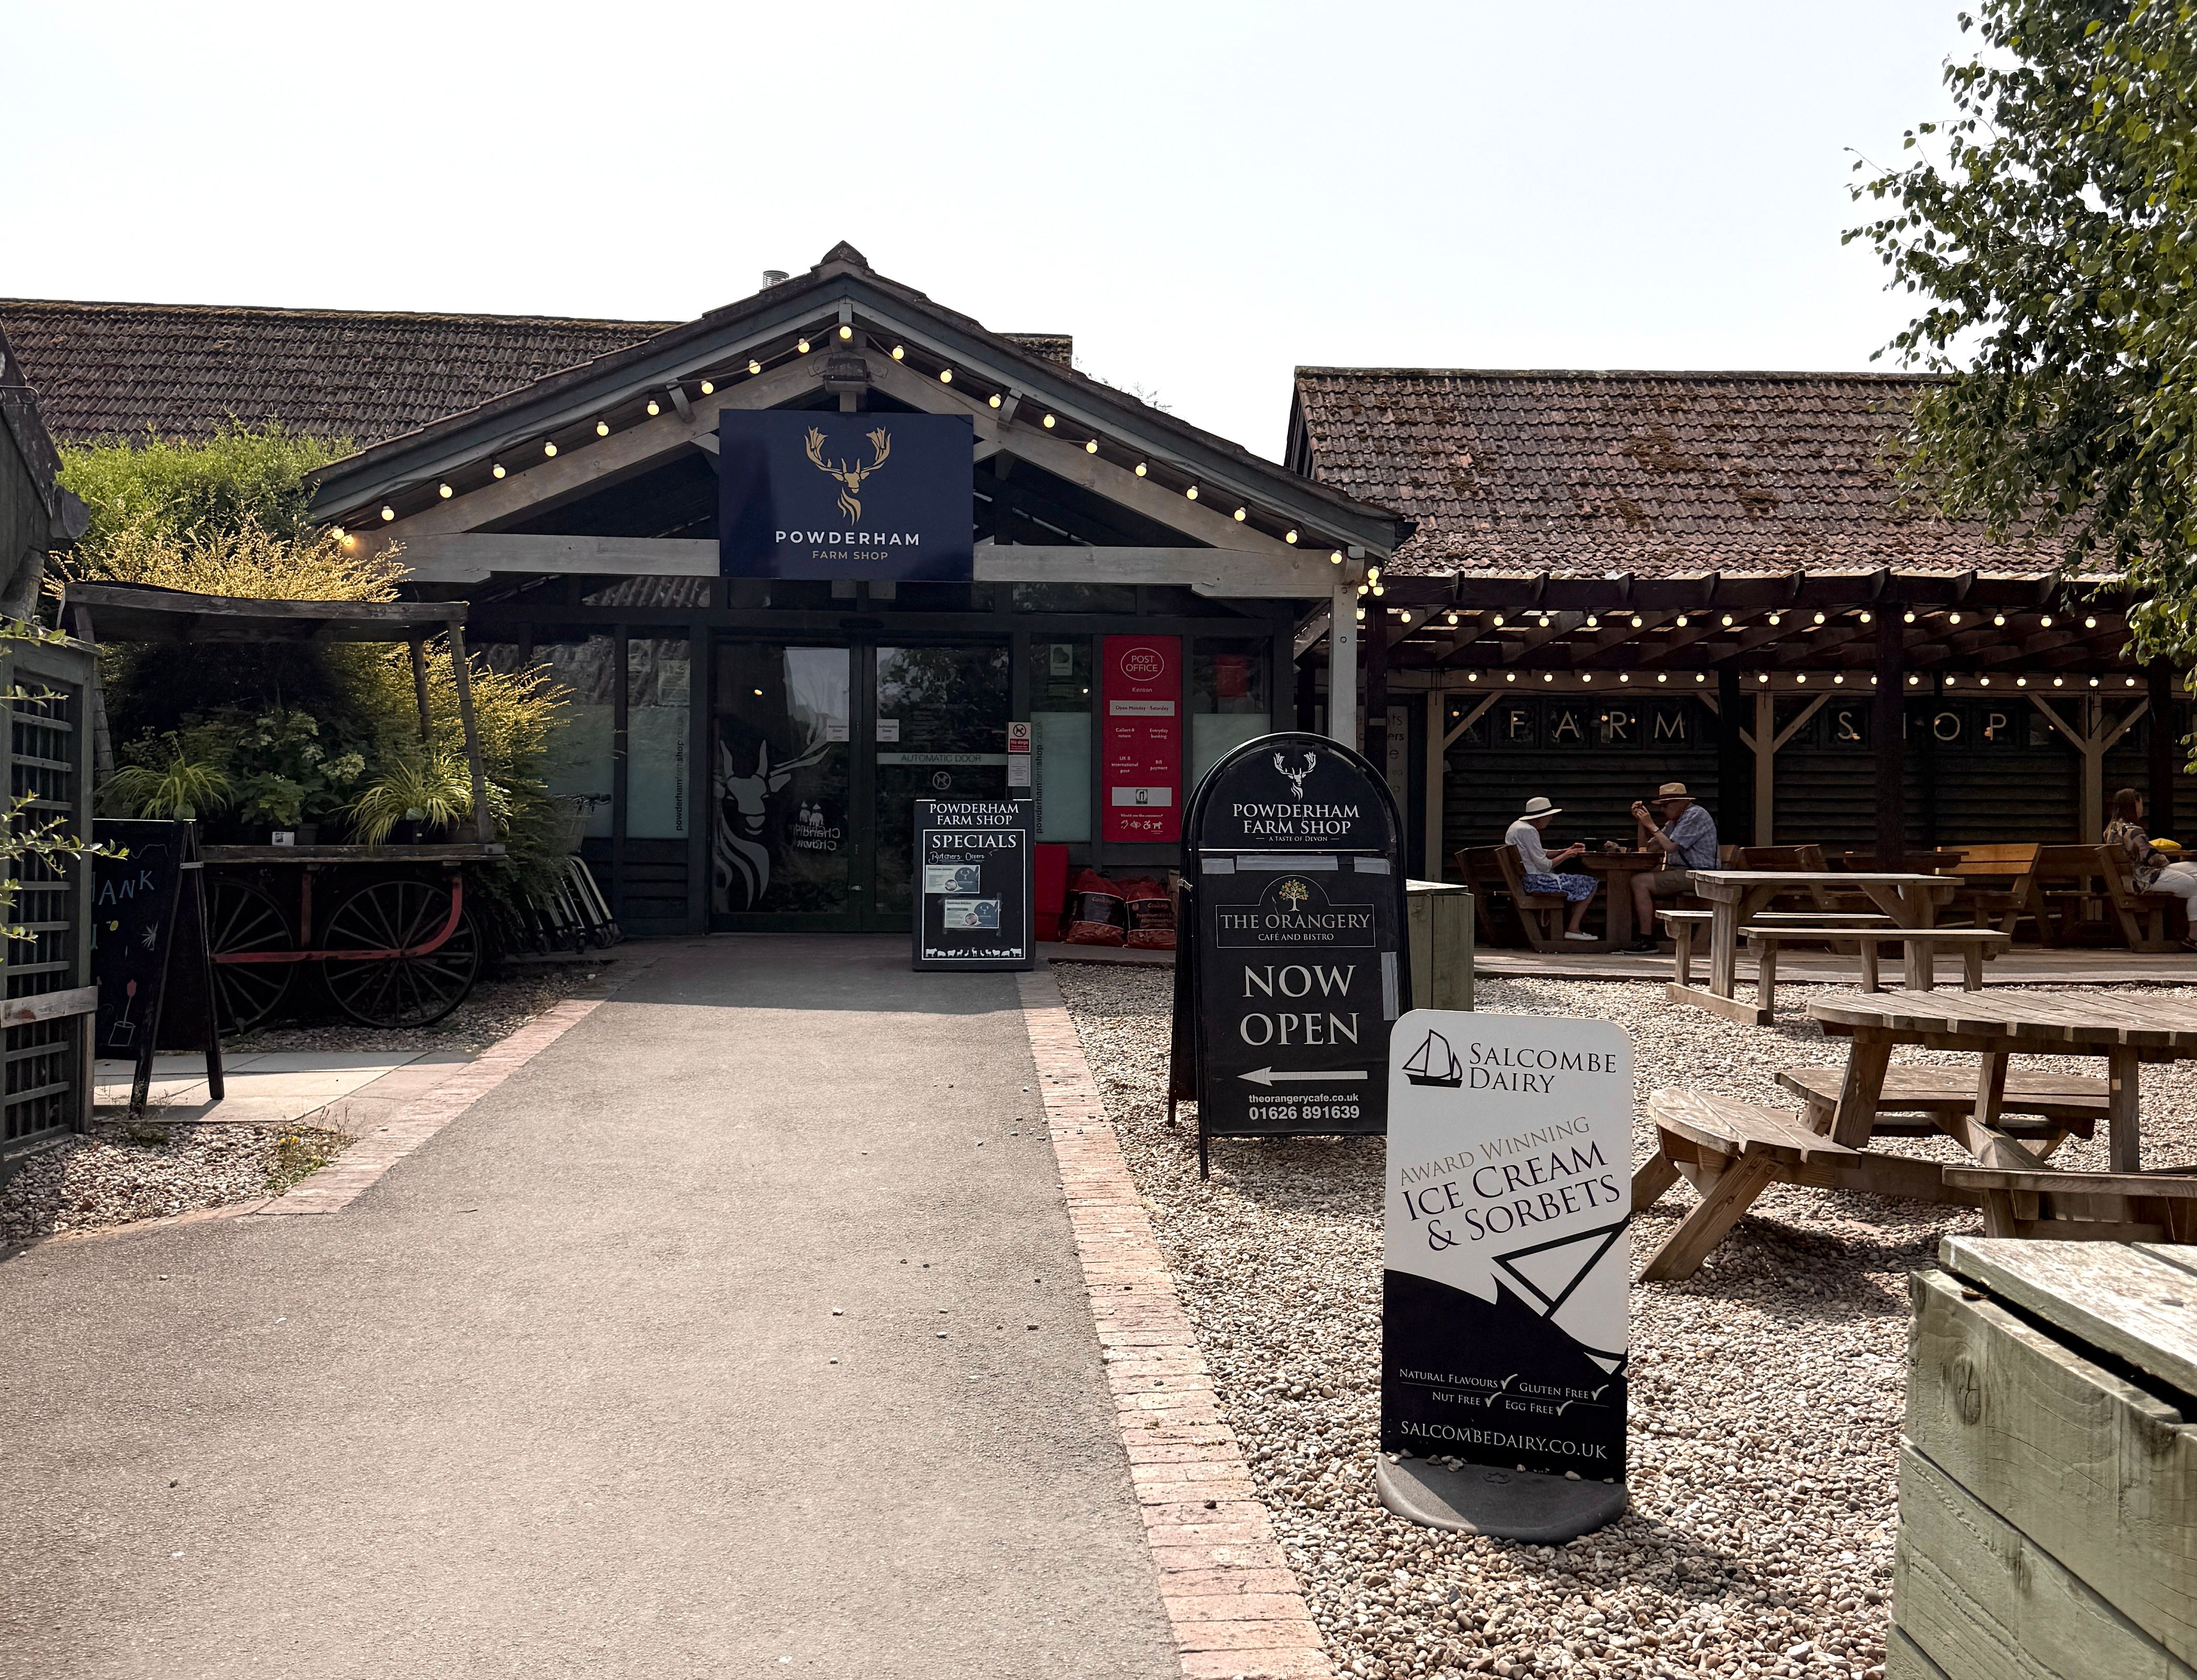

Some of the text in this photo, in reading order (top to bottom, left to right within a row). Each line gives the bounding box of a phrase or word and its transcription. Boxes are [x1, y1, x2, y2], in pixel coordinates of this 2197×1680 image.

[776, 531, 919, 546] POWDERHAM
[812, 551, 887, 560] FARM SHOP
[1510, 710, 2007, 741] FARM SOP
[930, 803, 1019, 813] POWDERHAM
[1232, 803, 1360, 818] POWDERHAM
[937, 815, 1013, 825] FARM SHOP
[1243, 820, 1351, 834] FARM SHOP
[932, 834, 1017, 848] SPECIALS
[1220, 914, 1371, 929] THE ORANGERY
[1258, 932, 1279, 941] CAFÉ
[1242, 964, 1357, 997] NOW
[1240, 1012, 1360, 1046] OPEN
[1469, 1042, 1617, 1073] SALCOMBE
[1469, 1066, 1555, 1093] DAIRY
[1248, 1093, 1360, 1104] theorangerycafe.co.uk
[1248, 1105, 1360, 1120] 01626 891639
[1400, 1116, 1590, 1186] AWARD WINNING
[1401, 1140, 1609, 1221] ICE CREAM
[1427, 1174, 1620, 1251] & SORBETS
[1399, 1368, 1498, 1388] NATURAL FLAVOURS
[1519, 1382, 1589, 1399] GLUTEN FREE
[1432, 1392, 1481, 1405] NUT FREE
[1505, 1400, 1554, 1415] EGG FREE
[1401, 1421, 1608, 1460] SALCOMBEDAIRY.CO.UK
